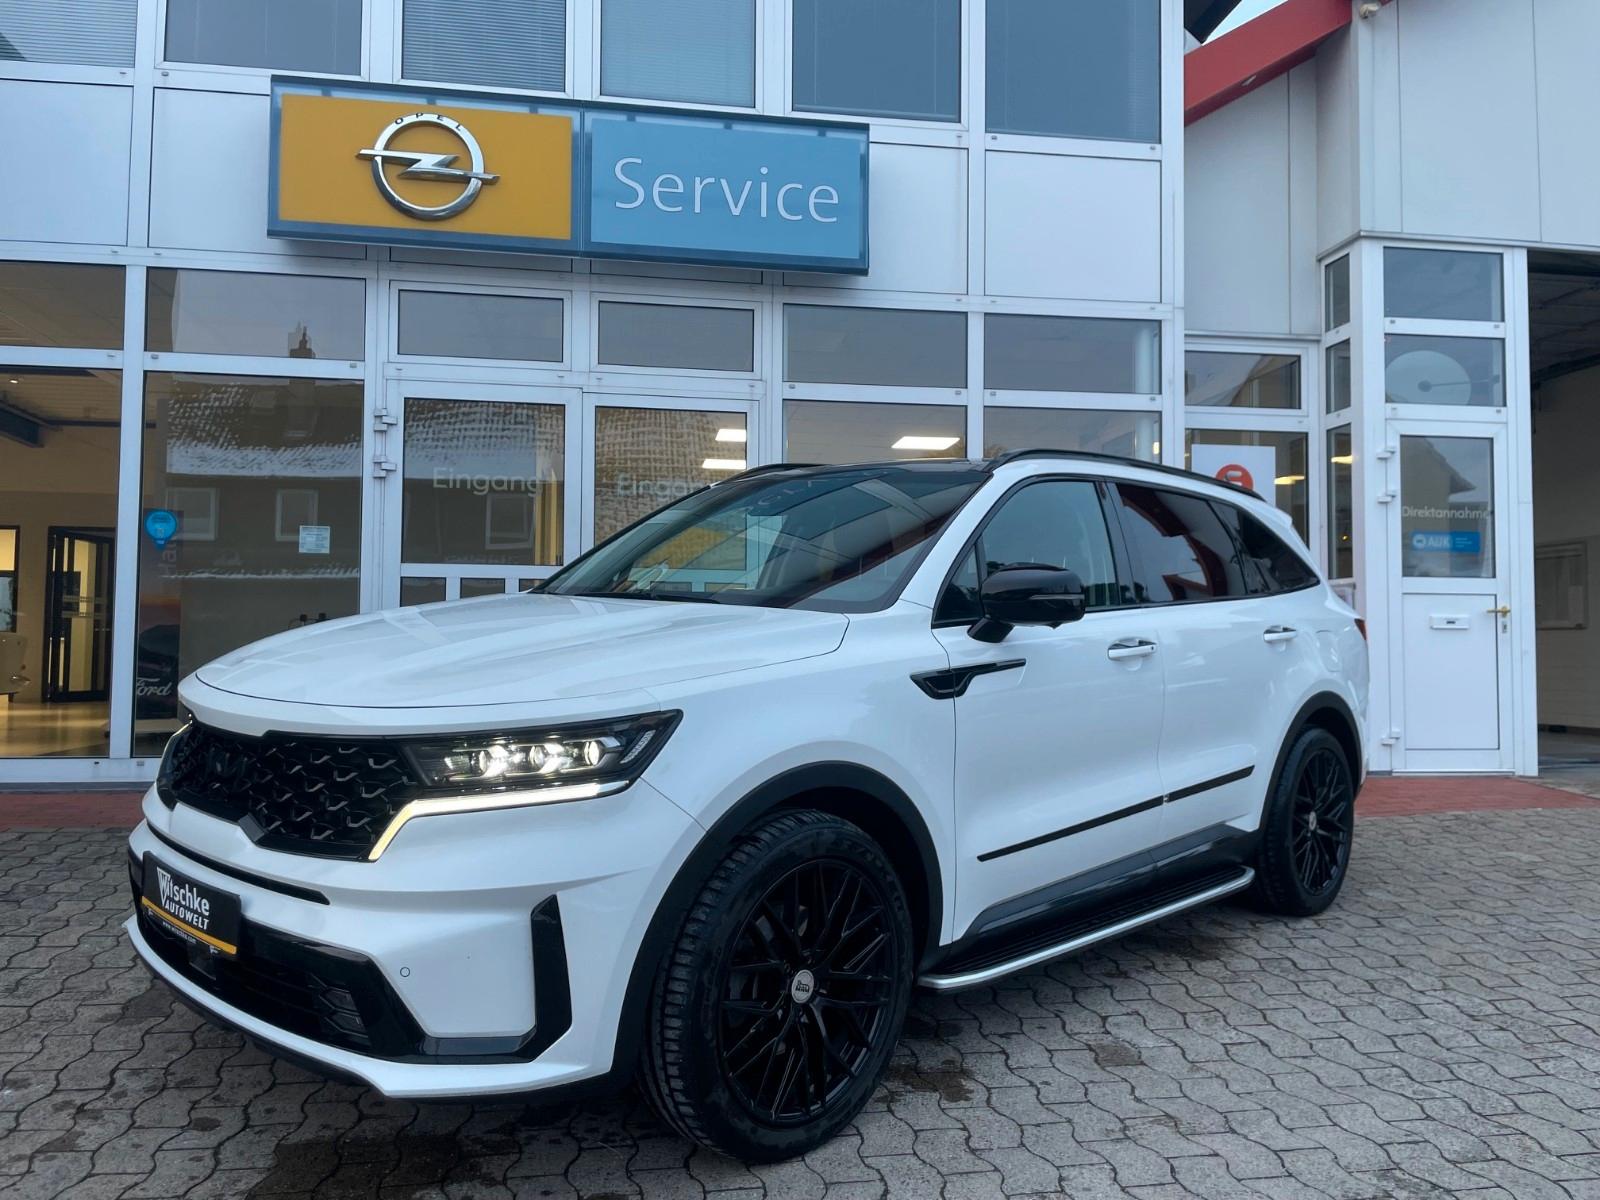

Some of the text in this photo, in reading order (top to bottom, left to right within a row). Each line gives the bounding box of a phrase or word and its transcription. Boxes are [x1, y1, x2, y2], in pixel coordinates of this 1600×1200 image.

[394, 112, 462, 132] OPEL
[614, 157, 840, 224] Service
[432, 467, 543, 497] Eingang
[617, 473, 705, 503] Eingan
[136, 677, 172, 697] Ford
[156, 866, 210, 916] Witschke
[164, 900, 210, 930] AUTOWELT
